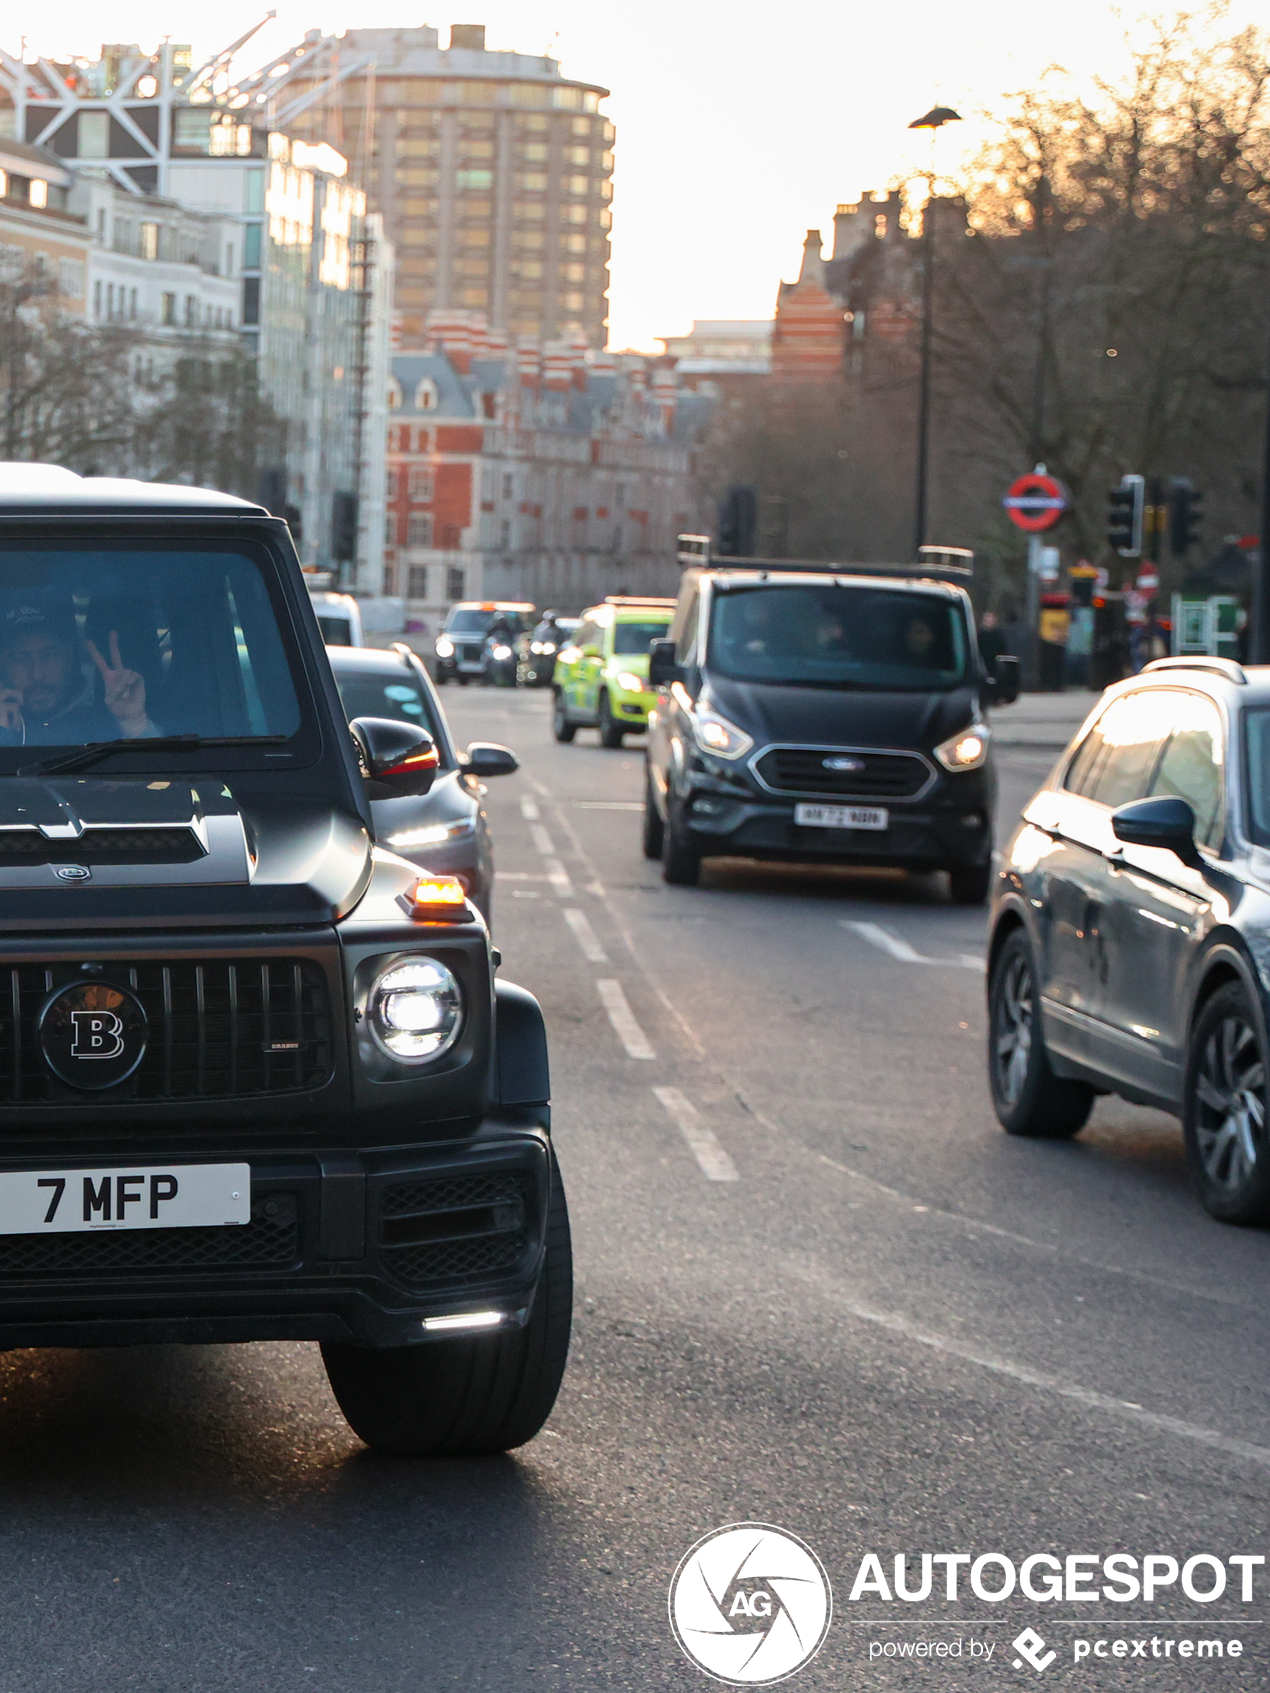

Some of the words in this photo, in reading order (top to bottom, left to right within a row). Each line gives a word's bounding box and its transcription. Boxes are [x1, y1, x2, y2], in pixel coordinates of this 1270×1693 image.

[71, 1011, 124, 1059] B
[37, 1178, 66, 1223] 7
[83, 1174, 178, 1222] MFP
